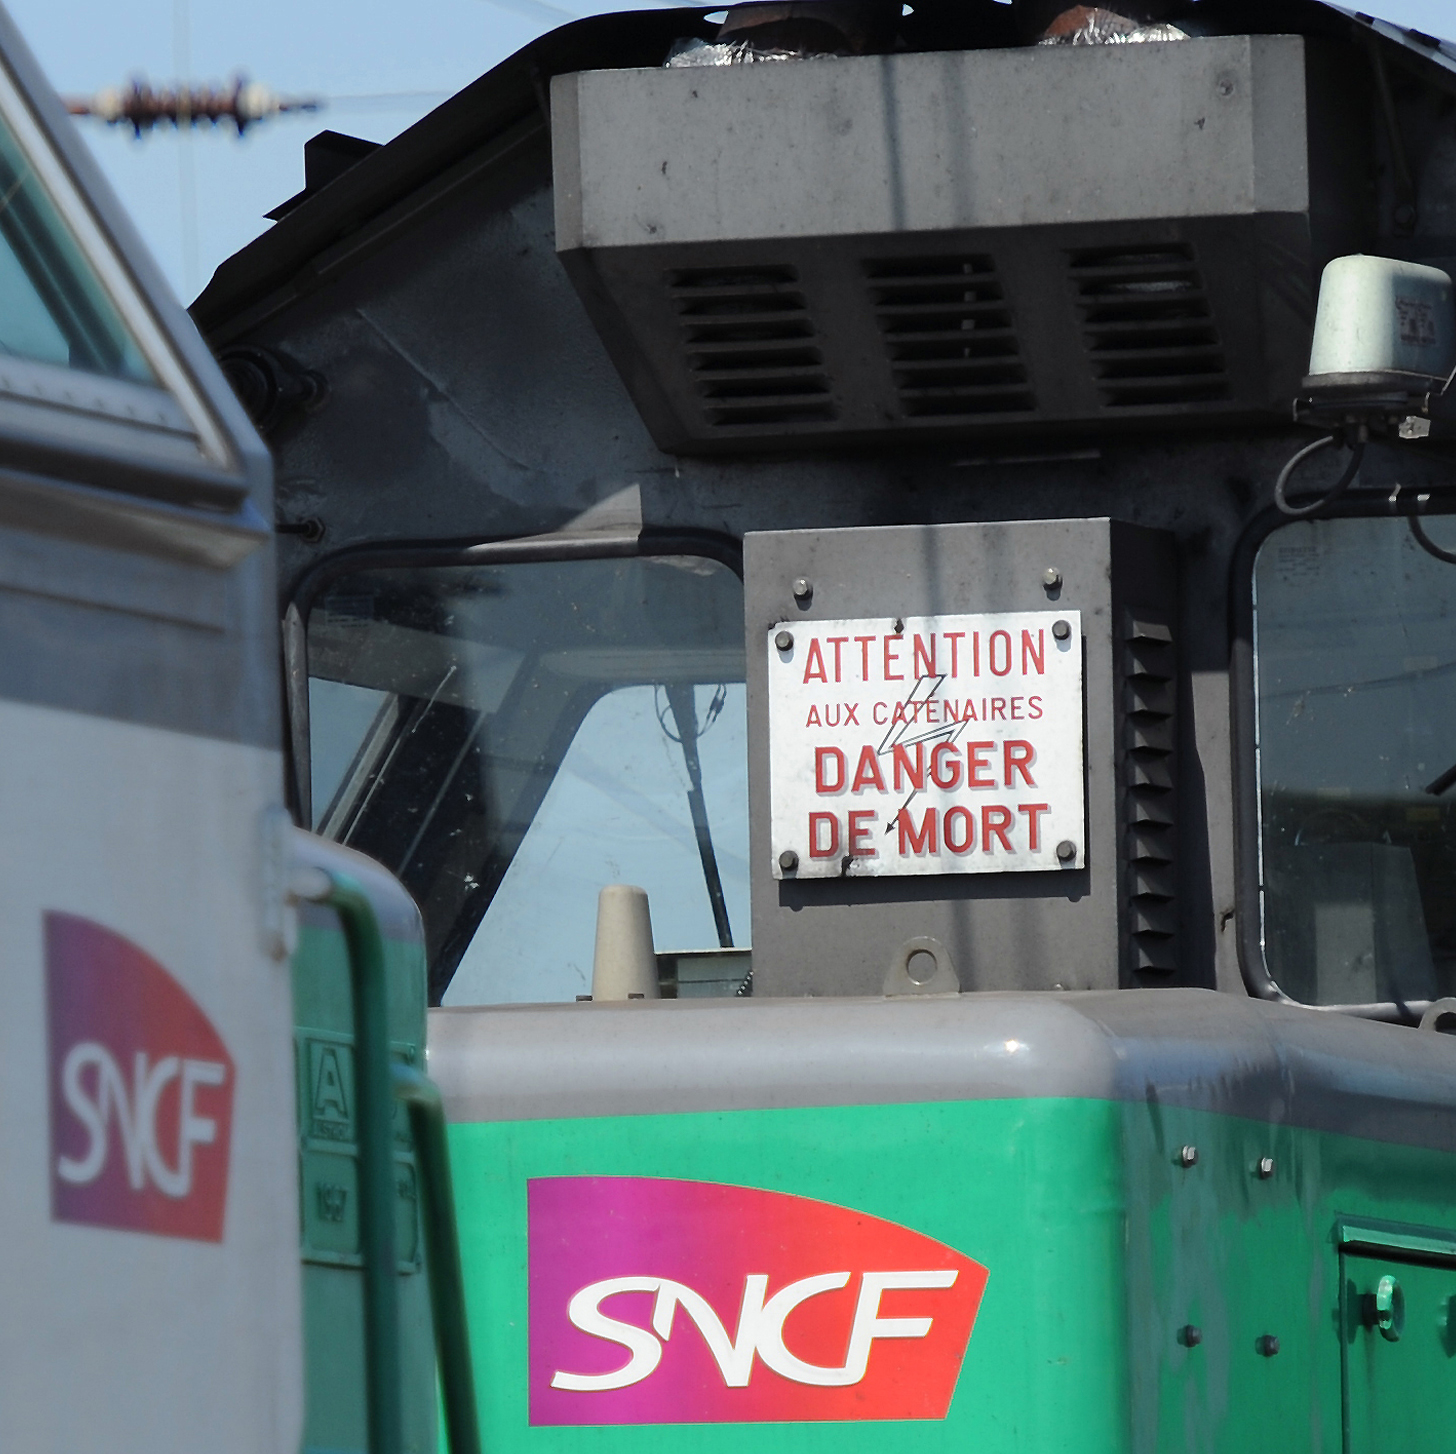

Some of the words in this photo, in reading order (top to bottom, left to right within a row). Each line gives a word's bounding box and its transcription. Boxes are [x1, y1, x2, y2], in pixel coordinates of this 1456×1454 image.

[802, 628, 1046, 685] ATTENTION
[806, 702, 860, 728] AUX
[814, 739, 1037, 794] DANGER
[808, 809, 878, 859] DE
[897, 802, 1049, 856] MORT
[56, 1040, 226, 1198] SNCF
[549, 1269, 960, 1392] SNCF
